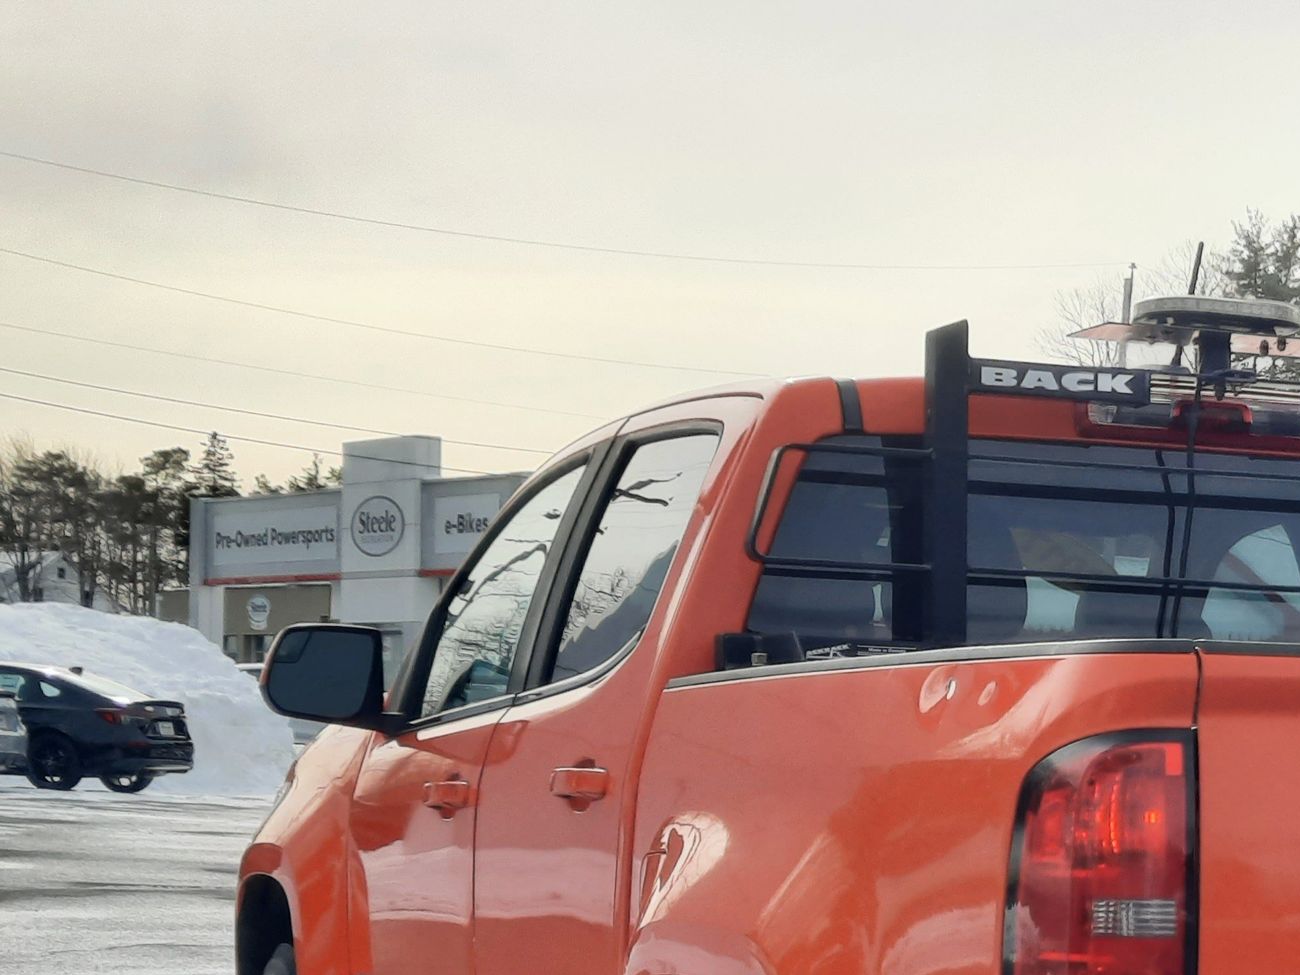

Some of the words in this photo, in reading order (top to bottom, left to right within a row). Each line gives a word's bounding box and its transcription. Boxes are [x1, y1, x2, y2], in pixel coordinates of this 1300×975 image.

[980, 366, 1134, 394] BACK
[358, 510, 396, 534] Steele
[445, 512, 488, 534] e-Bikes
[215, 527, 269, 550] Pre-Owned
[270, 524, 335, 550] Powersports
